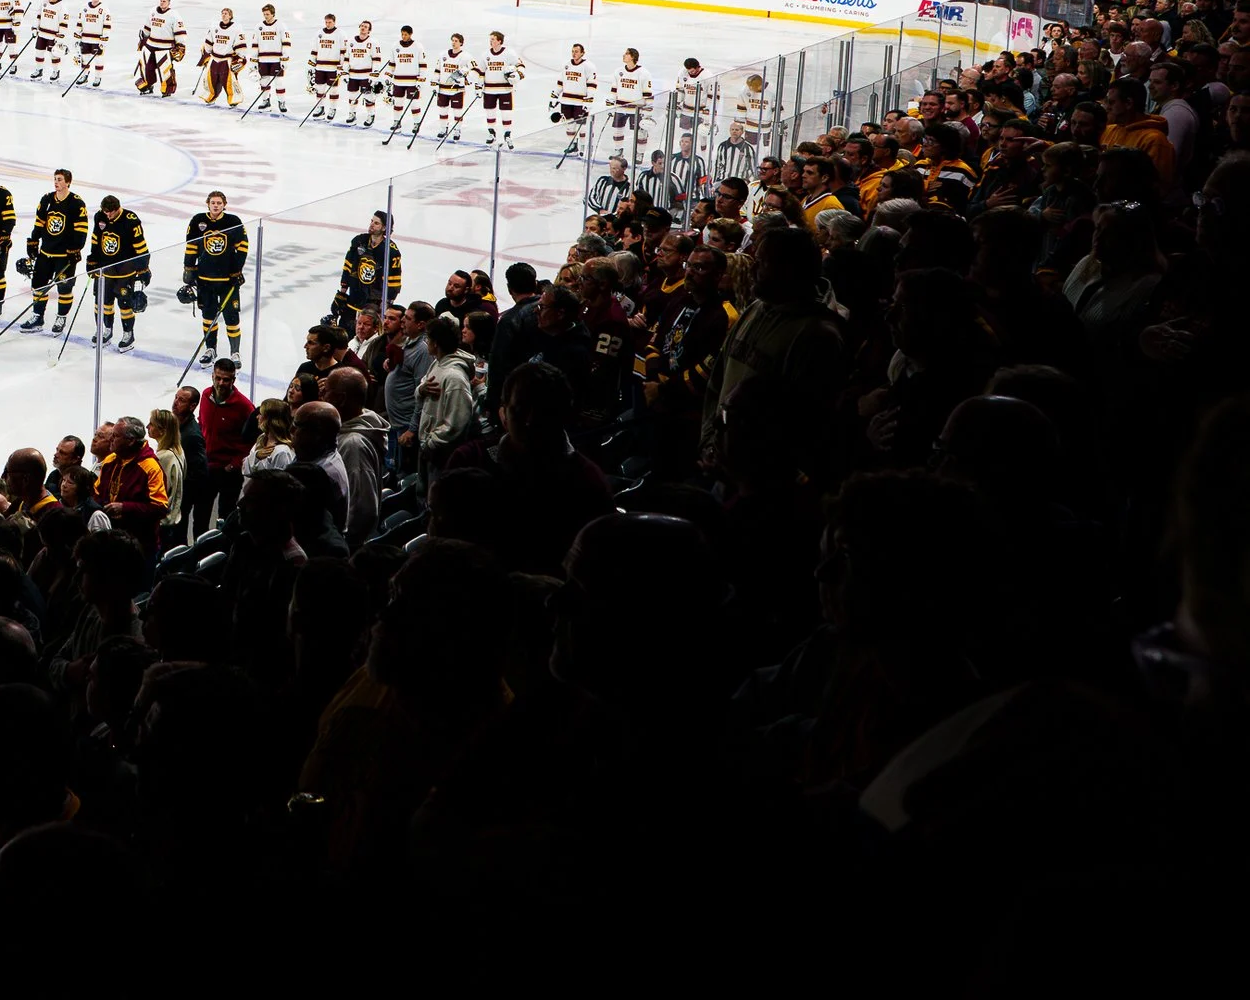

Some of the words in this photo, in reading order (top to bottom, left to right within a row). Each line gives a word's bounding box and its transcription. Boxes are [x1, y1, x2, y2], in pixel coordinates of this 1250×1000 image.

[801, 4, 836, 14] PLUMBING
[843, 9, 870, 17] CARING
[133, 227, 143, 237] 21
[391, 257, 401, 268] 27
[595, 333, 623, 358] 22
